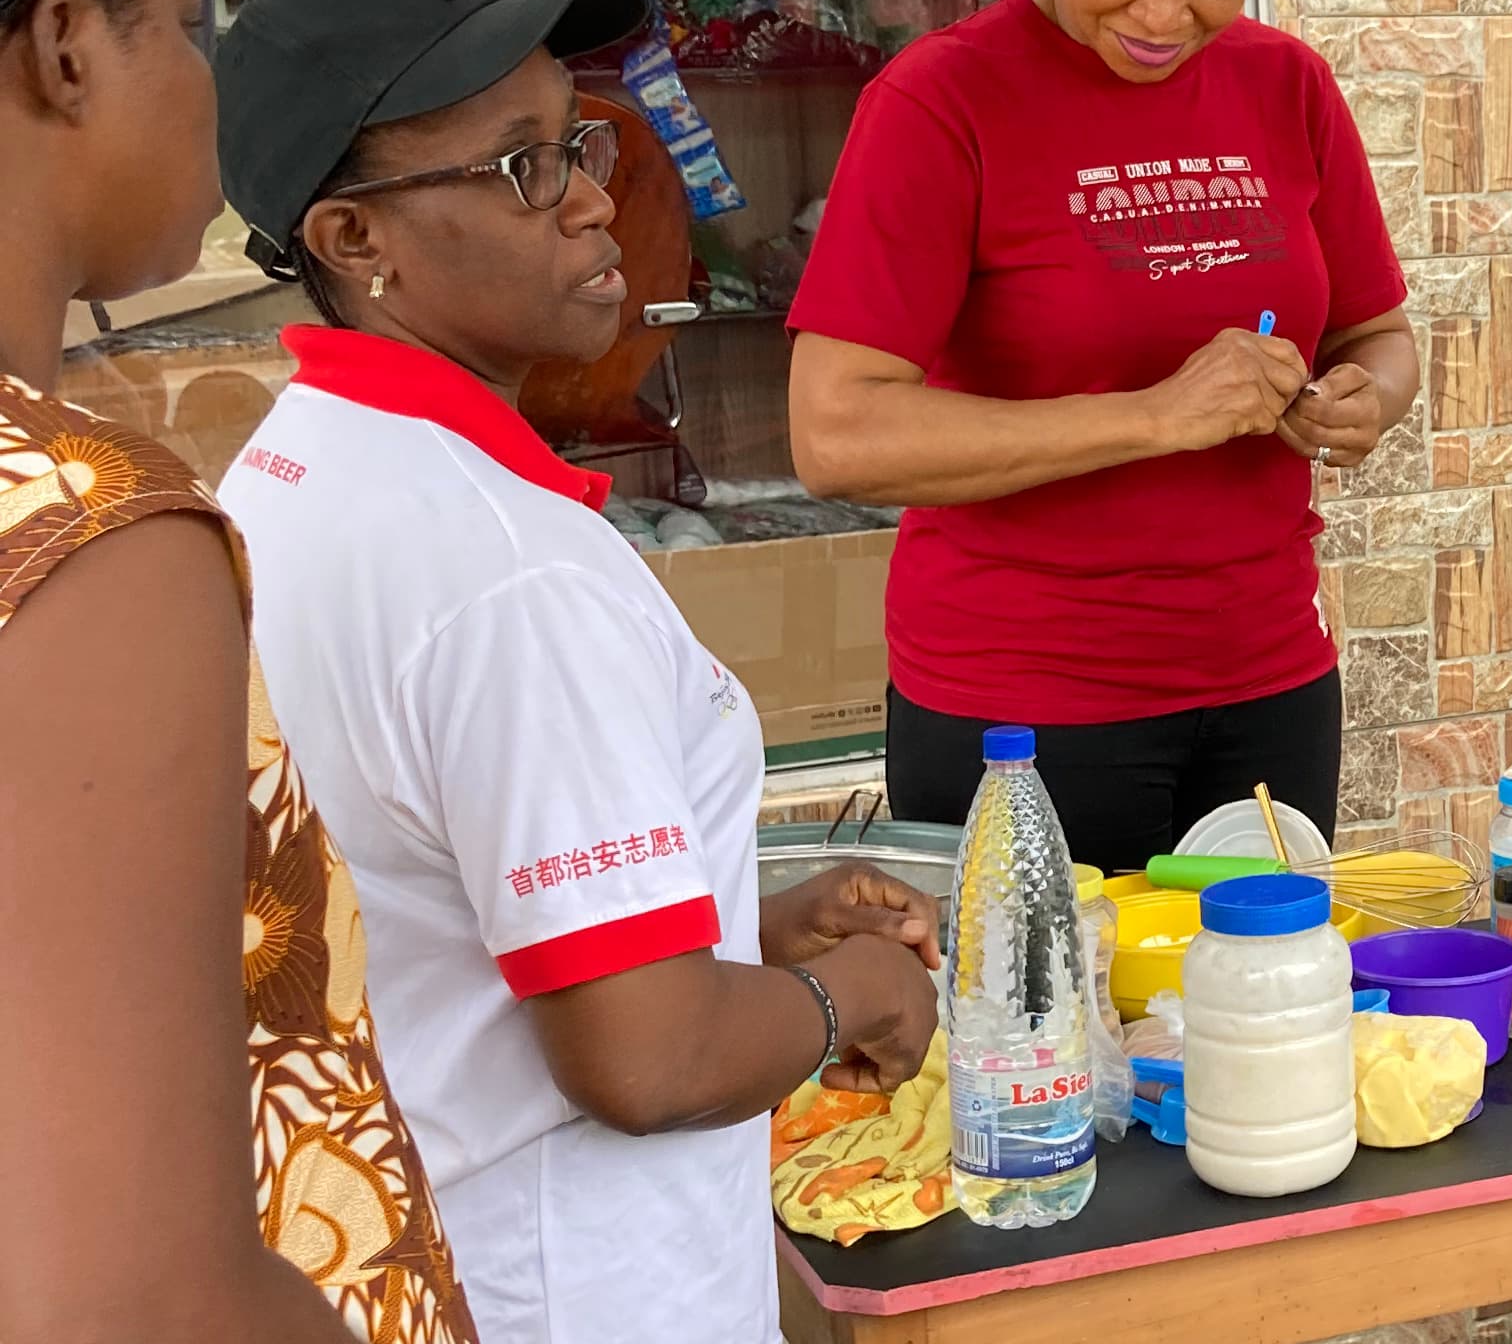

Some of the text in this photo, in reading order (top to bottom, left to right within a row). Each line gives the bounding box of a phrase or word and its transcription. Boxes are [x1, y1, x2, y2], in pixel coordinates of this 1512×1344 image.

[1124, 159, 1172, 179] UNION
[1177, 158, 1212, 173] MADE
[1143, 244, 1186, 254] LONDON
[1191, 239, 1241, 252] ENGLAND
[268, 453, 307, 487] BEER
[1010, 1082, 1048, 1106] La
